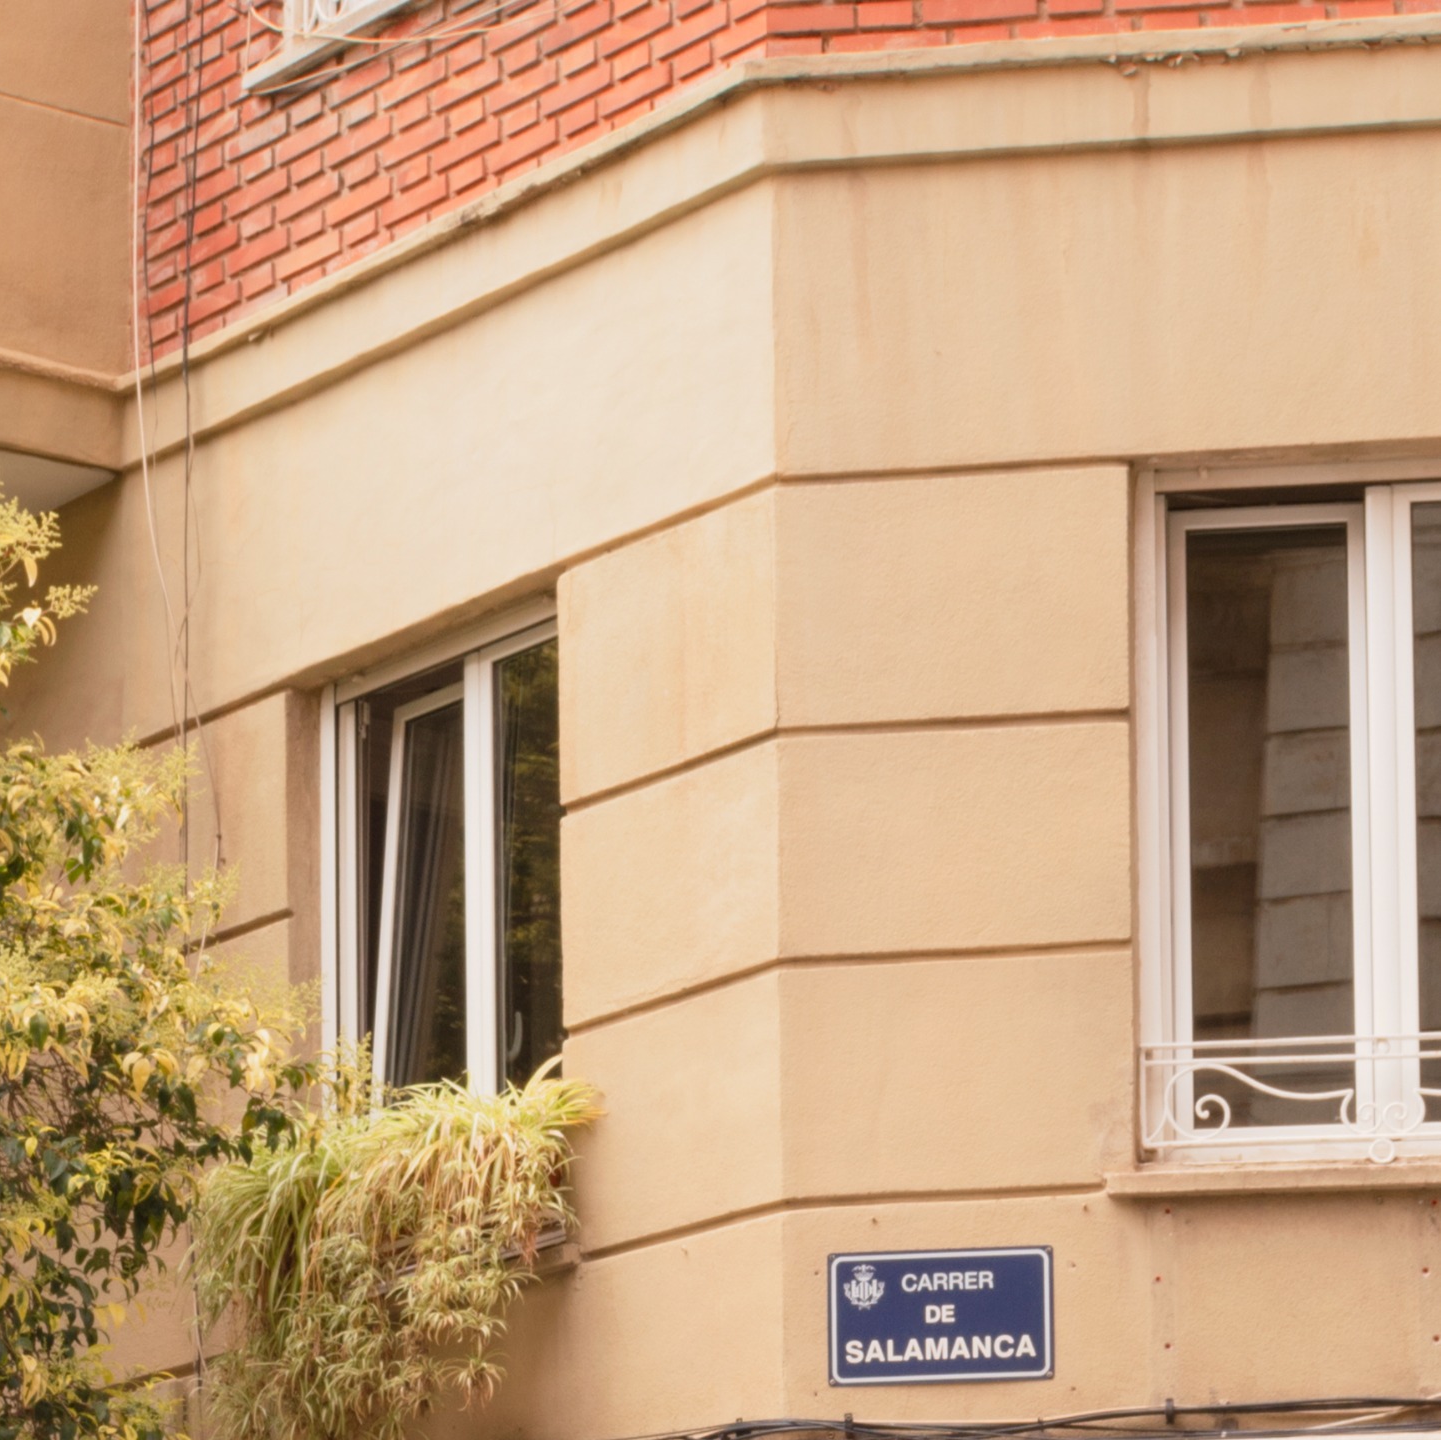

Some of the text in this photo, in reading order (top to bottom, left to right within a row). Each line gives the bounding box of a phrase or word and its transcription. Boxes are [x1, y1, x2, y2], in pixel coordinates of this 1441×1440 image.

[901, 1271, 994, 1292] CARRER
[925, 1304, 955, 1324] DE
[845, 1334, 1037, 1364] SALAMANCA
